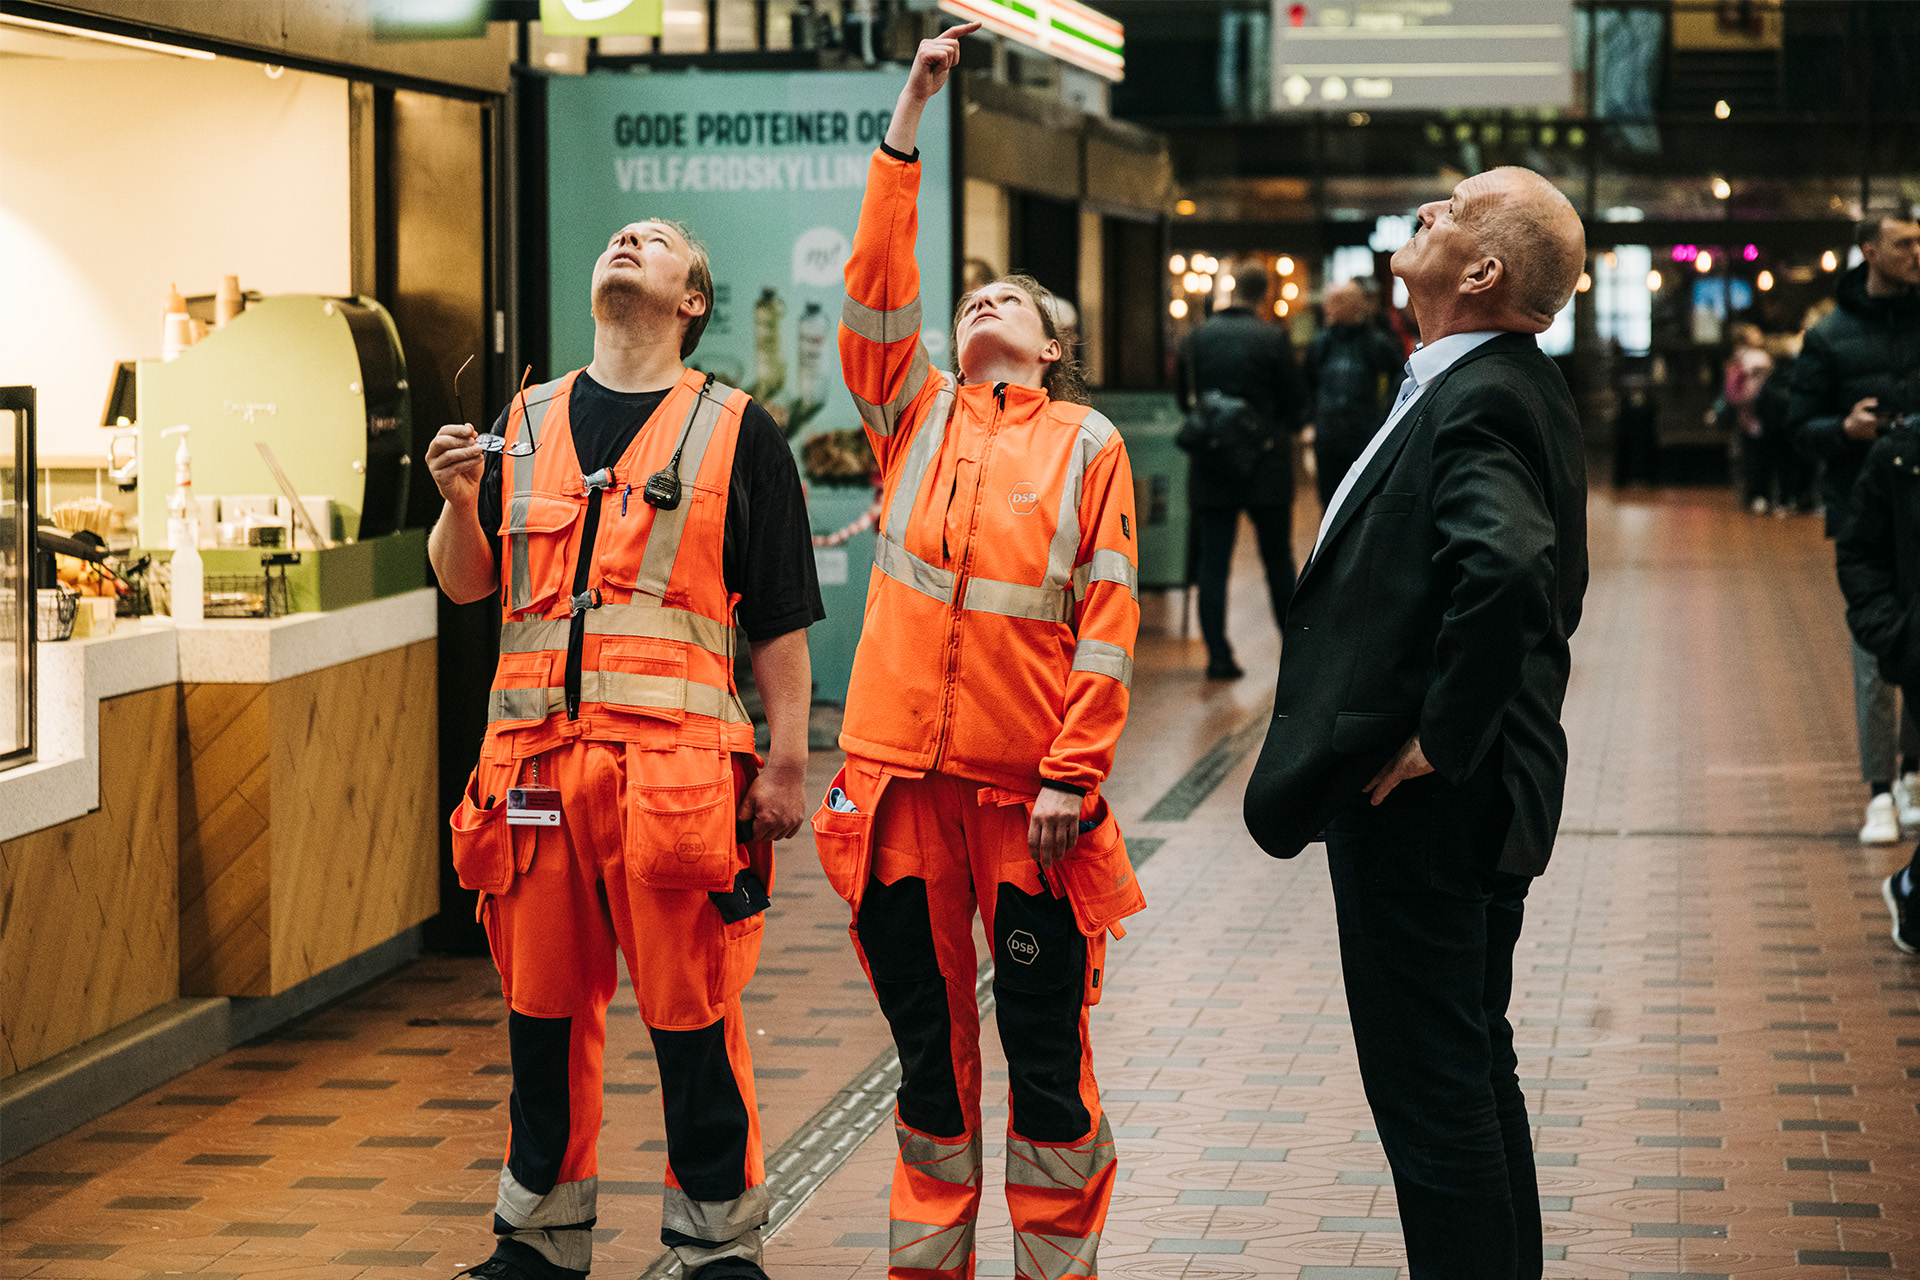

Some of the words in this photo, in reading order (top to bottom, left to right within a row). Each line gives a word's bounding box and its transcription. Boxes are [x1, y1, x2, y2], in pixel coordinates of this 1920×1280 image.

[615, 113, 687, 147] GODE
[696, 111, 849, 145] PROTEINER
[613, 154, 869, 192] VELFÆRDSKYLLIN
[1012, 493, 1037, 503] DSB
[679, 843, 701, 853] DSB
[1011, 939, 1035, 955] DSB
